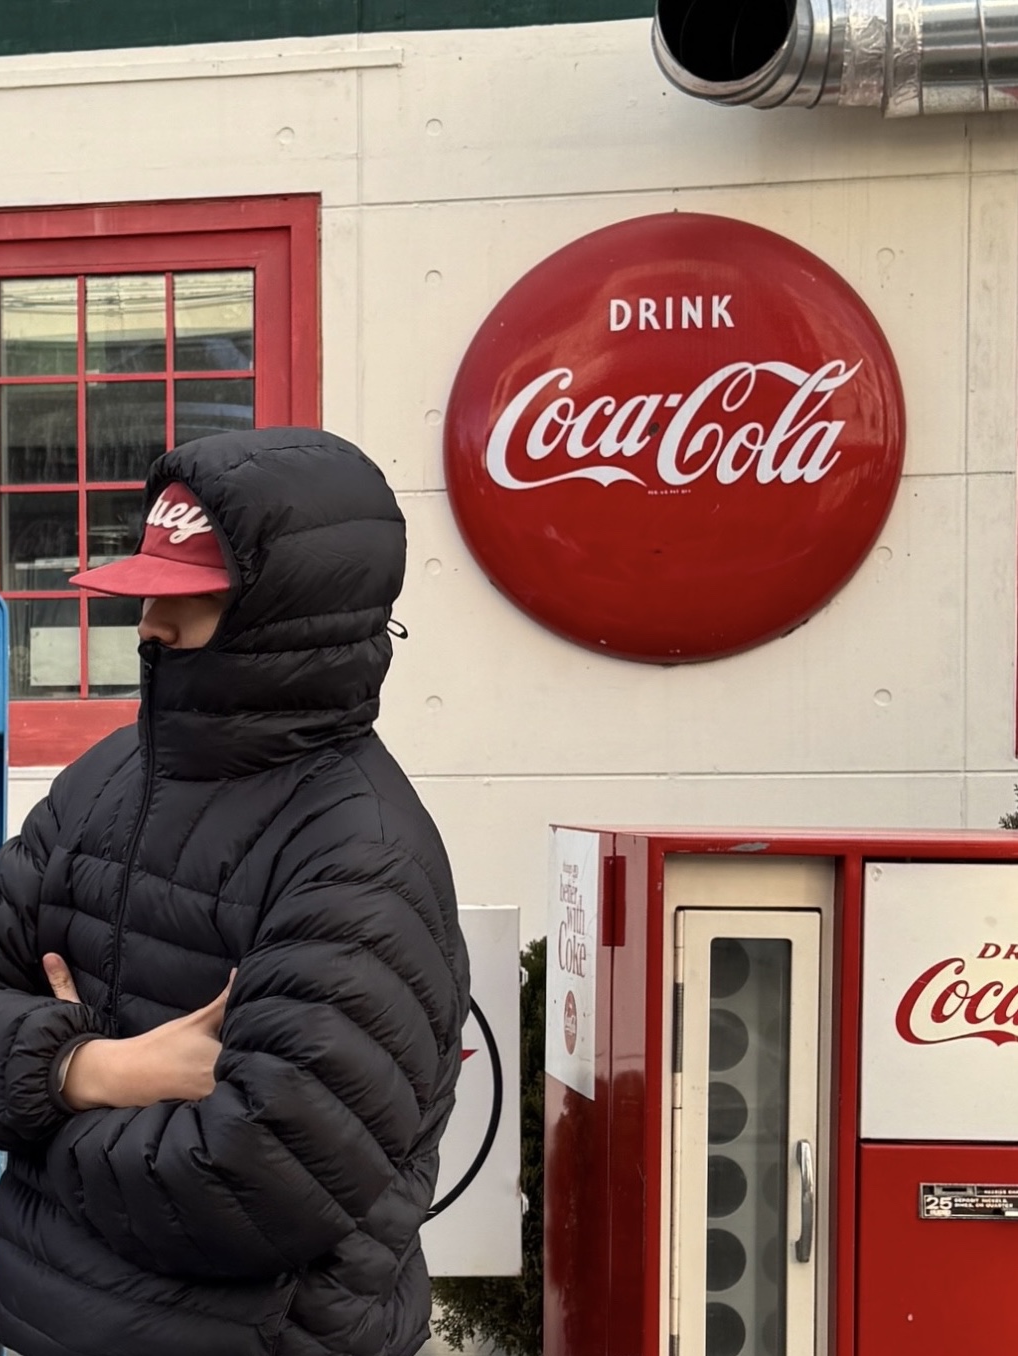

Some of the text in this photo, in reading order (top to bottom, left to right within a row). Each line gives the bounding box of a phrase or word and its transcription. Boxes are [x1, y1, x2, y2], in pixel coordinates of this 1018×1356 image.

[609, 294, 735, 331] DRINK
[485, 357, 863, 491] Coca-Cola
[557, 920, 587, 978] Coke
[926, 1196, 953, 1210] 25
